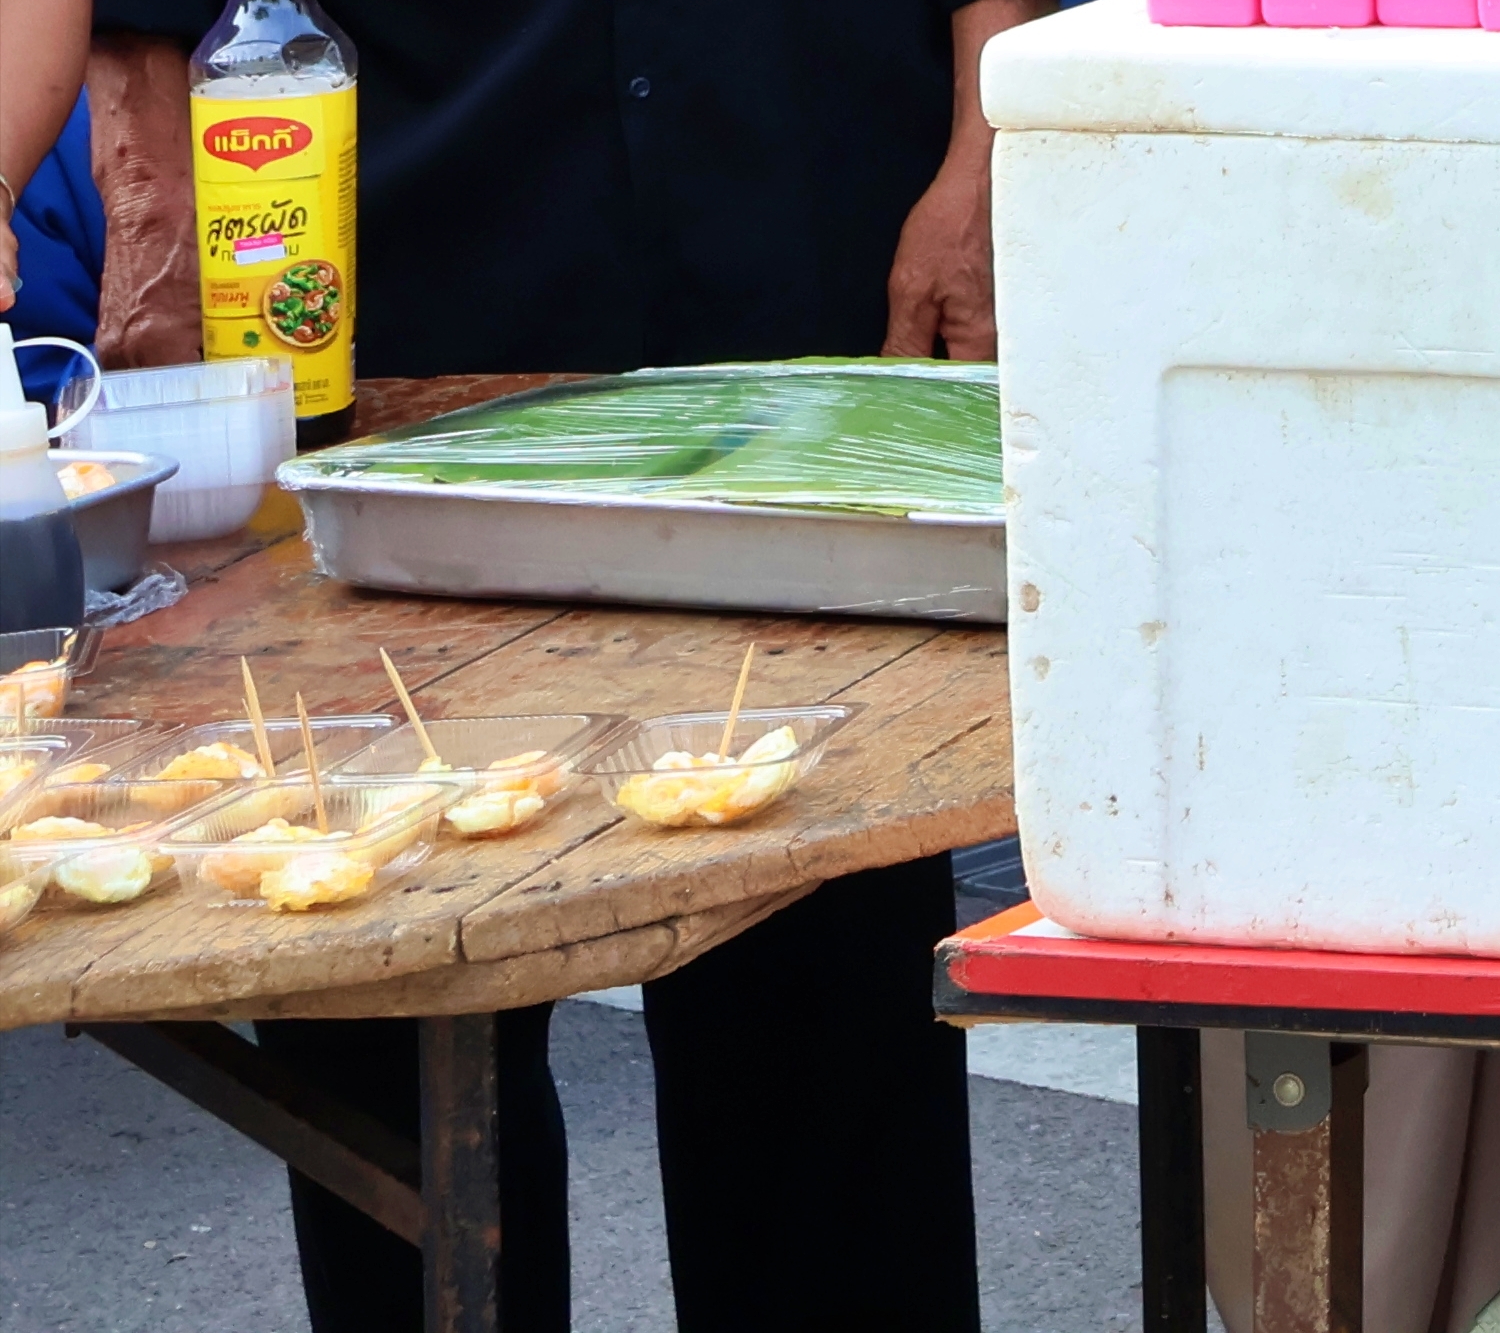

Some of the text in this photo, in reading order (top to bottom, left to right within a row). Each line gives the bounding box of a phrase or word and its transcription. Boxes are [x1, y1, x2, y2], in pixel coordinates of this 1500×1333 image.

[215, 125, 299, 152] แม็กกี้
[207, 199, 307, 256] สูตรผัด
